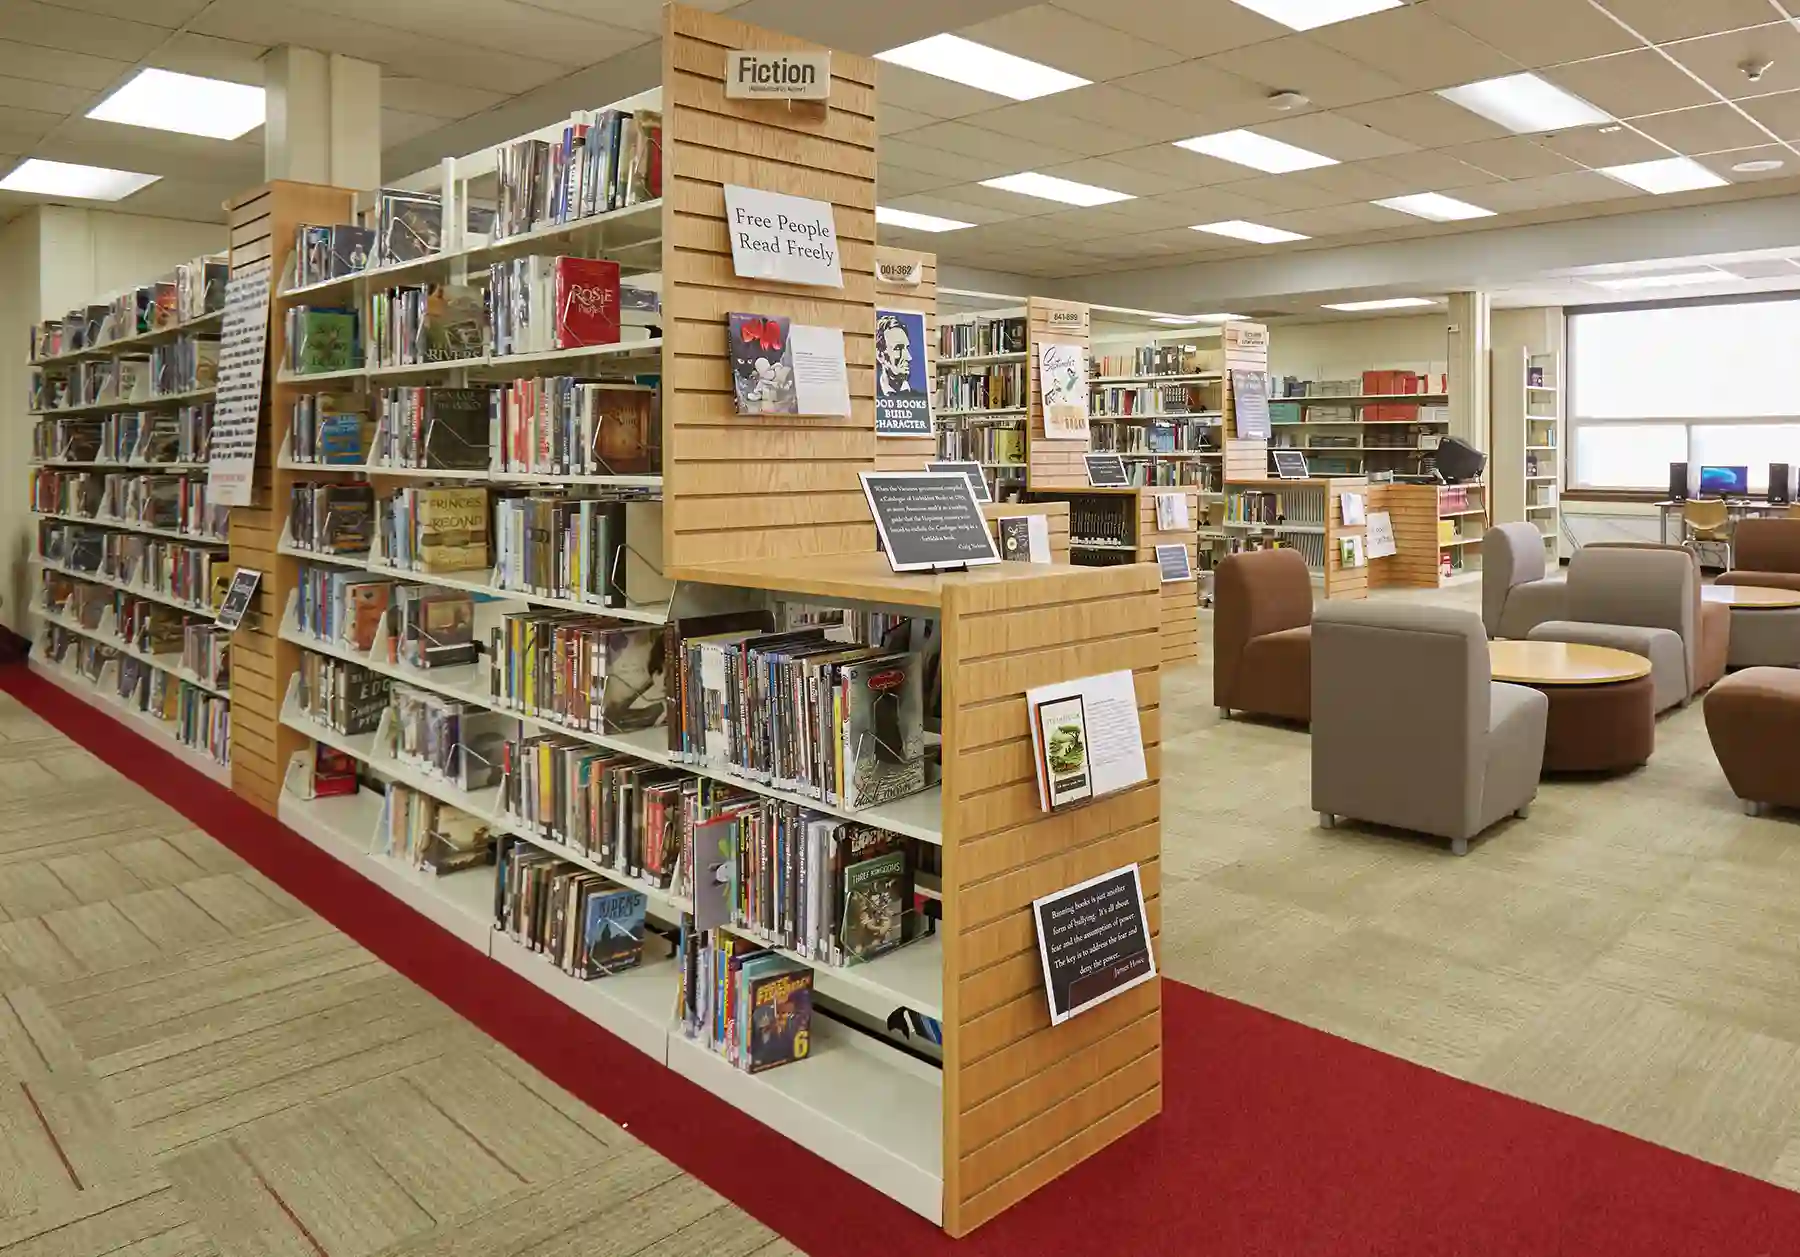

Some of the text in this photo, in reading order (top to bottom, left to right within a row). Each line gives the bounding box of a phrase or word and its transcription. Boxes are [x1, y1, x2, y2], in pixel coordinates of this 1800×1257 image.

[738, 57, 815, 84] Fiction
[736, 207, 830, 241] Free People
[738, 232, 834, 267] Read Freely
[880, 264, 912, 275] 001-362
[876, 399, 927, 409] OOD BOOKS
[884, 409, 913, 419] BUILD
[852, 870, 869, 886] THREE
[1052, 906, 1075, 919] Banning
[1074, 898, 1090, 910] books
[1096, 893, 1106, 904] just
[1107, 885, 1125, 897] another
[1053, 926, 1067, 936] form
[1067, 919, 1074, 929] of
[1098, 907, 1108, 916] It's
[1115, 900, 1130, 910] about
[1051, 944, 1062, 953] fear
[1063, 937, 1074, 948] and
[1074, 934, 1083, 944] the
[1084, 923, 1113, 939] assumption
[1113, 916, 1118, 927] of
[1054, 959, 1066, 969] The
[1065, 955, 1076, 965] key
[1077, 951, 1082, 959] is
[1090, 942, 1108, 954] address
[1109, 936, 1117, 945] the
[1117, 932, 1127, 941] fear
[1128, 925, 1138, 936] and
[1079, 965, 1093, 975] deny
[1093, 959, 1102, 968] the
[1113, 957, 1145, 978] James Howe
[794, 1031, 809, 1058] 6
